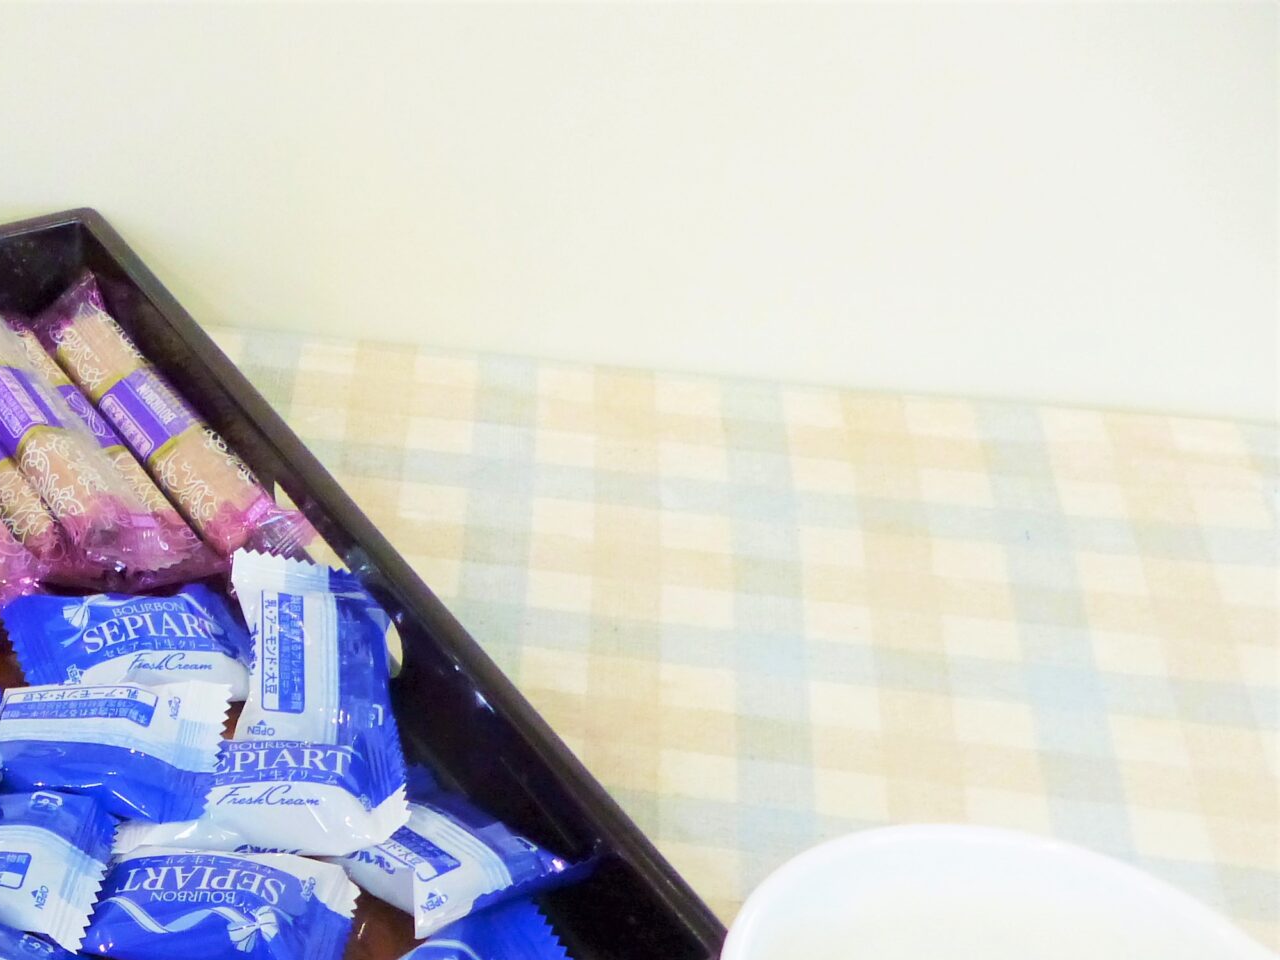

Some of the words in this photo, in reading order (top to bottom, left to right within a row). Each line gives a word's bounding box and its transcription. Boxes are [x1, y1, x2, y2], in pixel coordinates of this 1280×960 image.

[112, 602, 186, 617] BOURBON
[82, 612, 218, 655] SEPIART
[264, 598, 278, 695] 乳・アーモンド・大豆
[247, 724, 276, 738] OPEN
[216, 744, 355, 776] EPIART
[216, 768, 339, 785] ピアート生クリーム
[37, 884, 50, 911] OPEN
[115, 866, 287, 906] SEPIART
[150, 890, 237, 904] BOURBON
